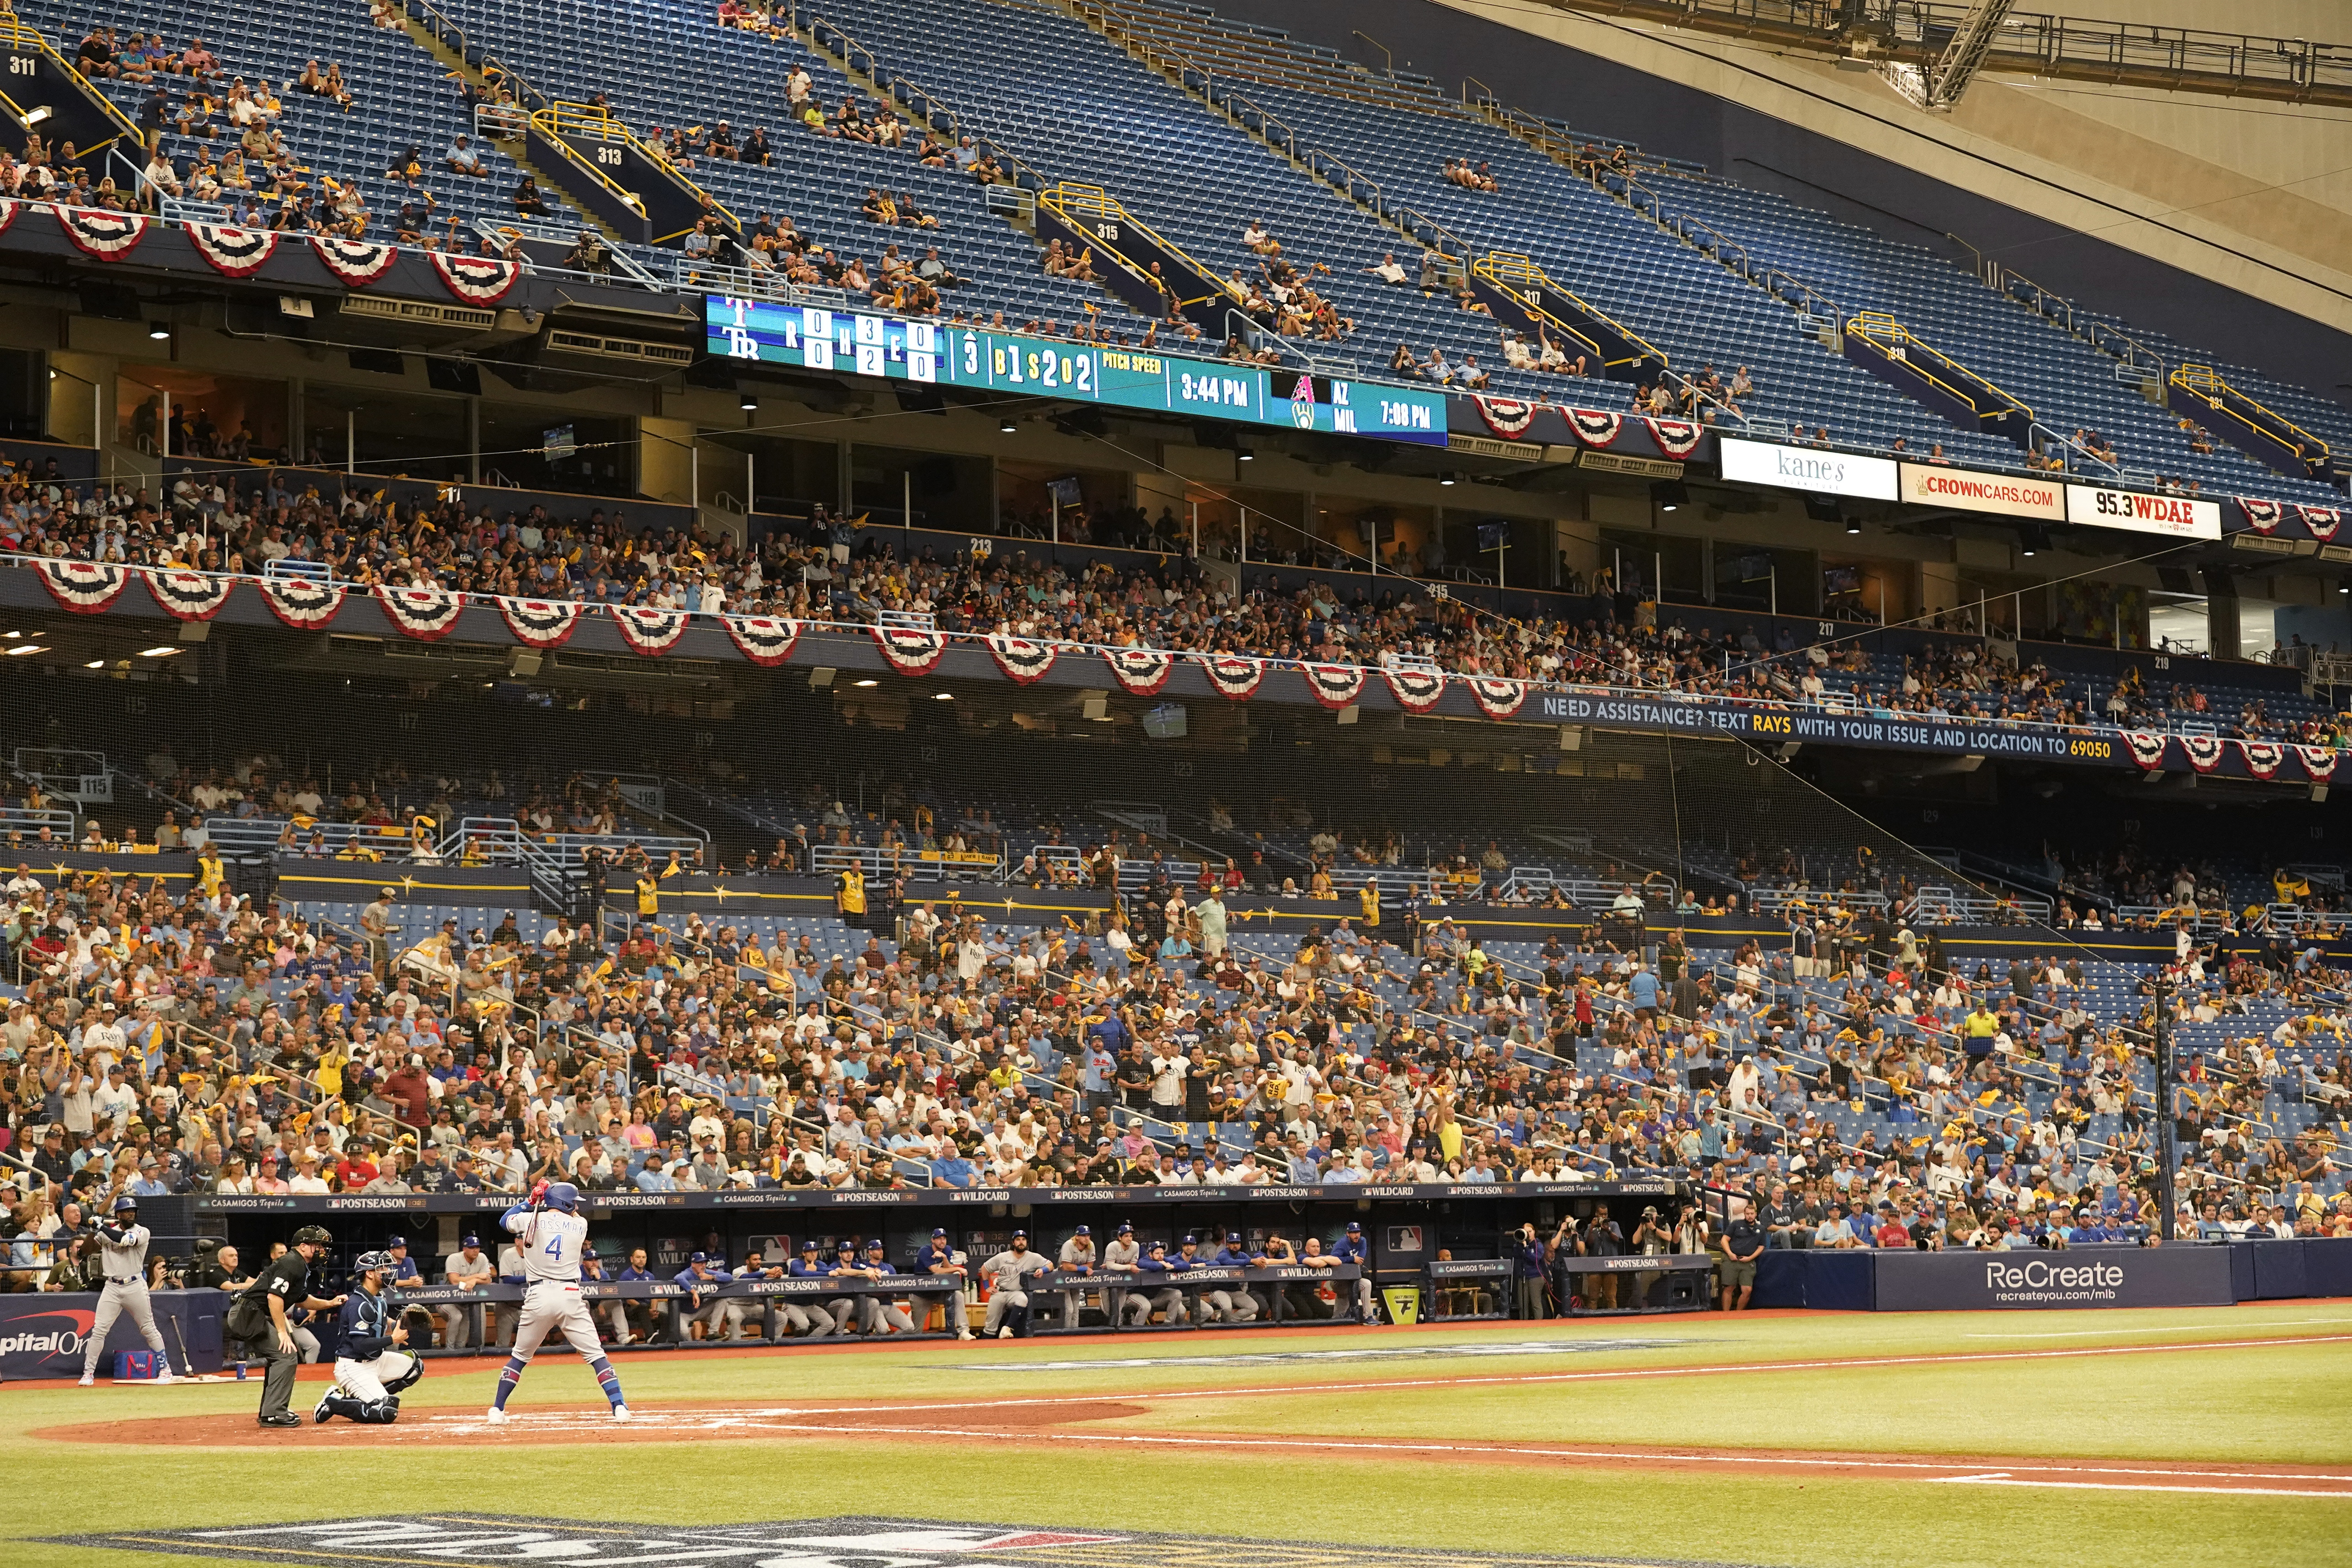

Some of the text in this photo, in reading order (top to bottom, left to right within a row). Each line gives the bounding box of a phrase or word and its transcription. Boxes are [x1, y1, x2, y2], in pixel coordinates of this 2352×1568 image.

[10, 56, 35, 76] 311
[598, 147, 622, 165] 313
[1098, 222, 1118, 241] 315
[1524, 289, 1540, 305] 317
[786, 321, 798, 348] R
[866, 319, 873, 341] 3
[839, 328, 851, 355] H
[890, 335, 901, 362] E
[867, 350, 874, 371] 2
[964, 341, 979, 375] 3
[1890, 347, 1906, 360] 319
[1102, 351, 1162, 375] PITCH SPEED
[1043, 350, 1058, 387] 2
[1076, 354, 1092, 391] 2
[1181, 372, 1248, 407] 3:44 PM
[1333, 381, 1349, 406] AZ
[1334, 408, 1357, 433] MIL
[1380, 400, 1431, 430] 7:08 PM
[1777, 448, 1845, 483] kane's
[1784, 478, 1839, 491] FURNITURE
[1927, 476, 2053, 508] CROWNCARS.COM
[970, 538, 992, 555] 213
[1429, 583, 1448, 598] 215
[1819, 622, 1834, 636] 217
[2155, 656, 2169, 670] 219
[1544, 698, 2111, 759] NEED ASSISTANCE? TEXT RAYS WITH YOUR ISSUE AND LOCATION TO 69050
[84, 778, 107, 795] 115
[1200, 1190, 1218, 1198] Tequila
[1259, 1188, 1308, 1197] POSTSEASON
[1372, 1187, 1414, 1196] WILDCARD
[1457, 1185, 1502, 1195] POSTSEASON
[1629, 1183, 1665, 1192] POSTSEAS
[606, 1196, 667, 1206] POSTSEASON
[724, 1194, 787, 1203] CASAMIGOS Tequila
[844, 1192, 900, 1202] POSTSEASON
[961, 1191, 1010, 1201] WILDCARD
[1062, 1190, 1114, 1200] POSTSEASON
[211, 1199, 284, 1209] CASAMIGOS Tequila
[341, 1198, 406, 1209] POSTSEASON
[544, 1233, 564, 1262] 4
[1479, 1263, 1496, 1272] Tequila
[1614, 1259, 1659, 1268] POSTSEASON
[1103, 1274, 1123, 1284] Tequila
[1178, 1269, 1229, 1280] POSTSEASON
[1287, 1267, 1333, 1278] WILDCARD
[1987, 1261, 2123, 1288] ReCreate
[271, 1277, 289, 1293] 73
[663, 1284, 719, 1295] WILCARD
[761, 1282, 821, 1292] POSTSEASON
[877, 1278, 939, 1287] CASAMIGOS Tequila
[406, 1289, 477, 1299] CASAMIGOS Tequila
[1996, 1289, 2116, 1302] recreateyou.com/mlb
